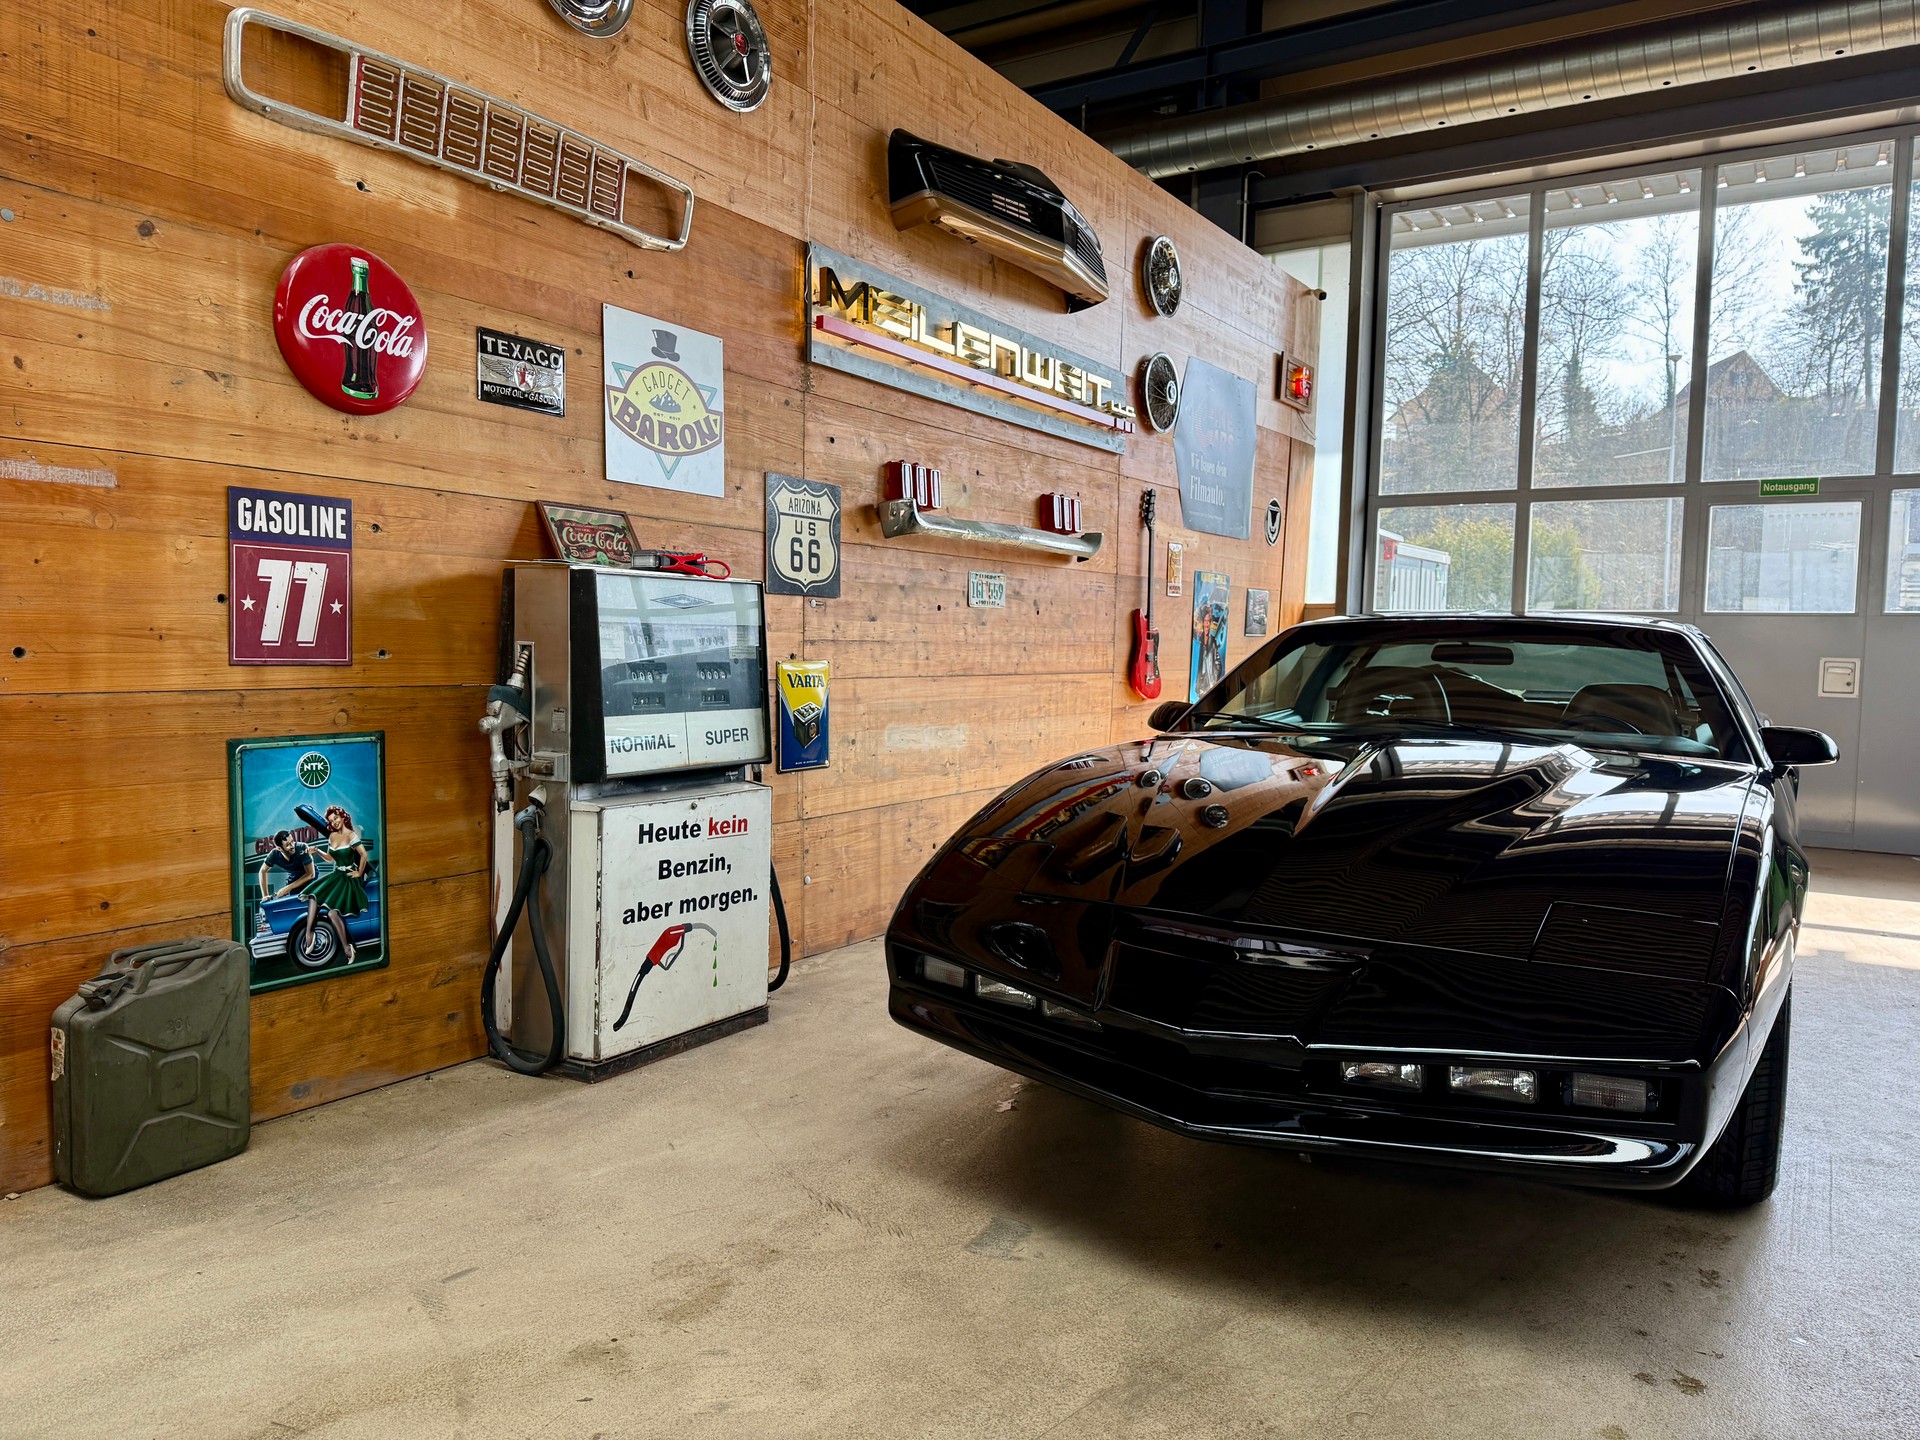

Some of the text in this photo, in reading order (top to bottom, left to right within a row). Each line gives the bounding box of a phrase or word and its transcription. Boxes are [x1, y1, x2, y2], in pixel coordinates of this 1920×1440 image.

[298, 294, 416, 358] Coca-Cola
[819, 266, 1111, 402] MEILENWEIT
[482, 335, 561, 368] TEXACO
[483, 383, 511, 397] MOTOR
[512, 389, 523, 399] OIL
[642, 370, 691, 401] GADGET
[615, 396, 718, 451] BARON
[1190, 475, 1225, 507] Filmauto.
[1763, 482, 1816, 492] Notausgang
[237, 497, 347, 540] GASOLINE
[788, 497, 822, 516] ARIZONA
[562, 526, 627, 552] Coca-Cola
[794, 519, 816, 537] US
[790, 536, 821, 574] 66
[256, 558, 329, 647] 77
[786, 672, 825, 689] VARTA
[610, 727, 750, 754] NORMAL SUPER
[638, 814, 749, 845] Heute kein
[658, 853, 732, 880] Benzin,
[622, 886, 758, 925] aber morgen.
